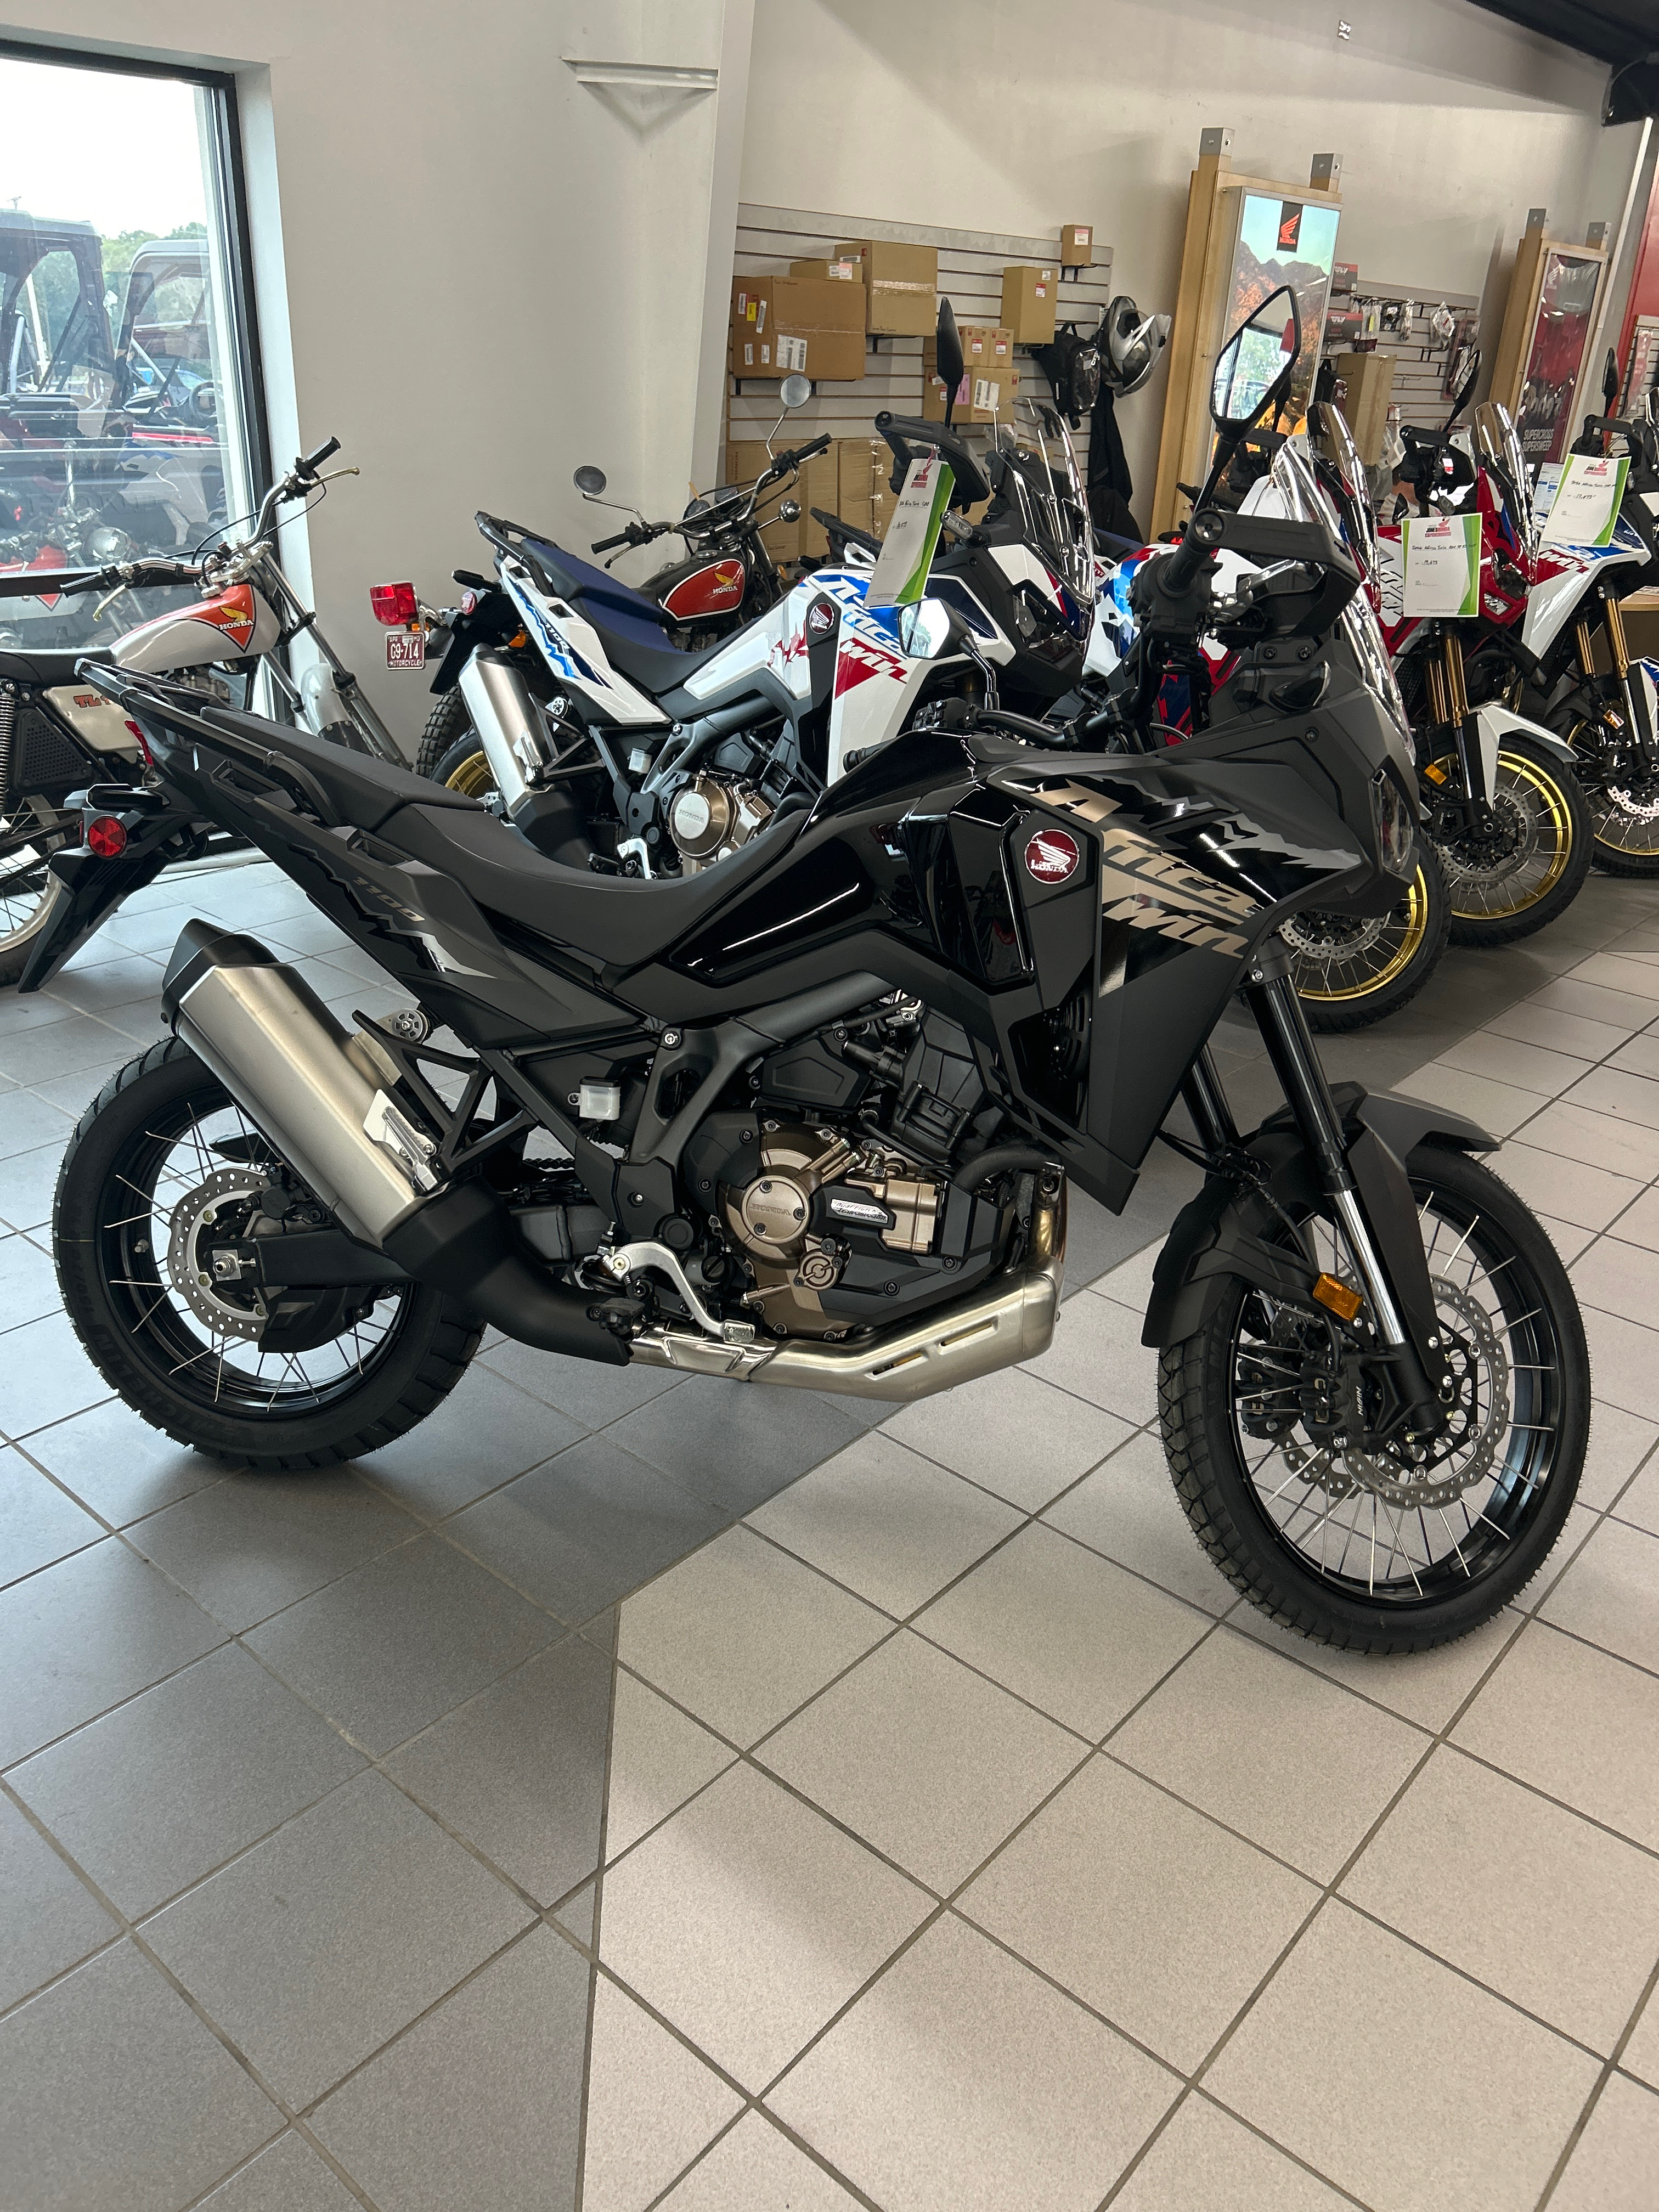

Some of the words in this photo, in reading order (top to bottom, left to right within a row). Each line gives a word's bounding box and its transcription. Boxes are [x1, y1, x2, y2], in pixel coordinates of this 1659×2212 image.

[1524, 428, 1554, 440] SUPERCROSS
[1522, 440, 1552, 452] SUPERSWEEP
[712, 585, 738, 594] HONDA
[219, 619, 255, 630] HONDA
[73, 694, 102, 708] TL
[679, 809, 704, 823] HONDA
[1030, 778, 1259, 918] Africa
[1030, 859, 1069, 873] HONDA
[352, 877, 425, 922] 1100
[751, 1203, 792, 1216] HONDA
